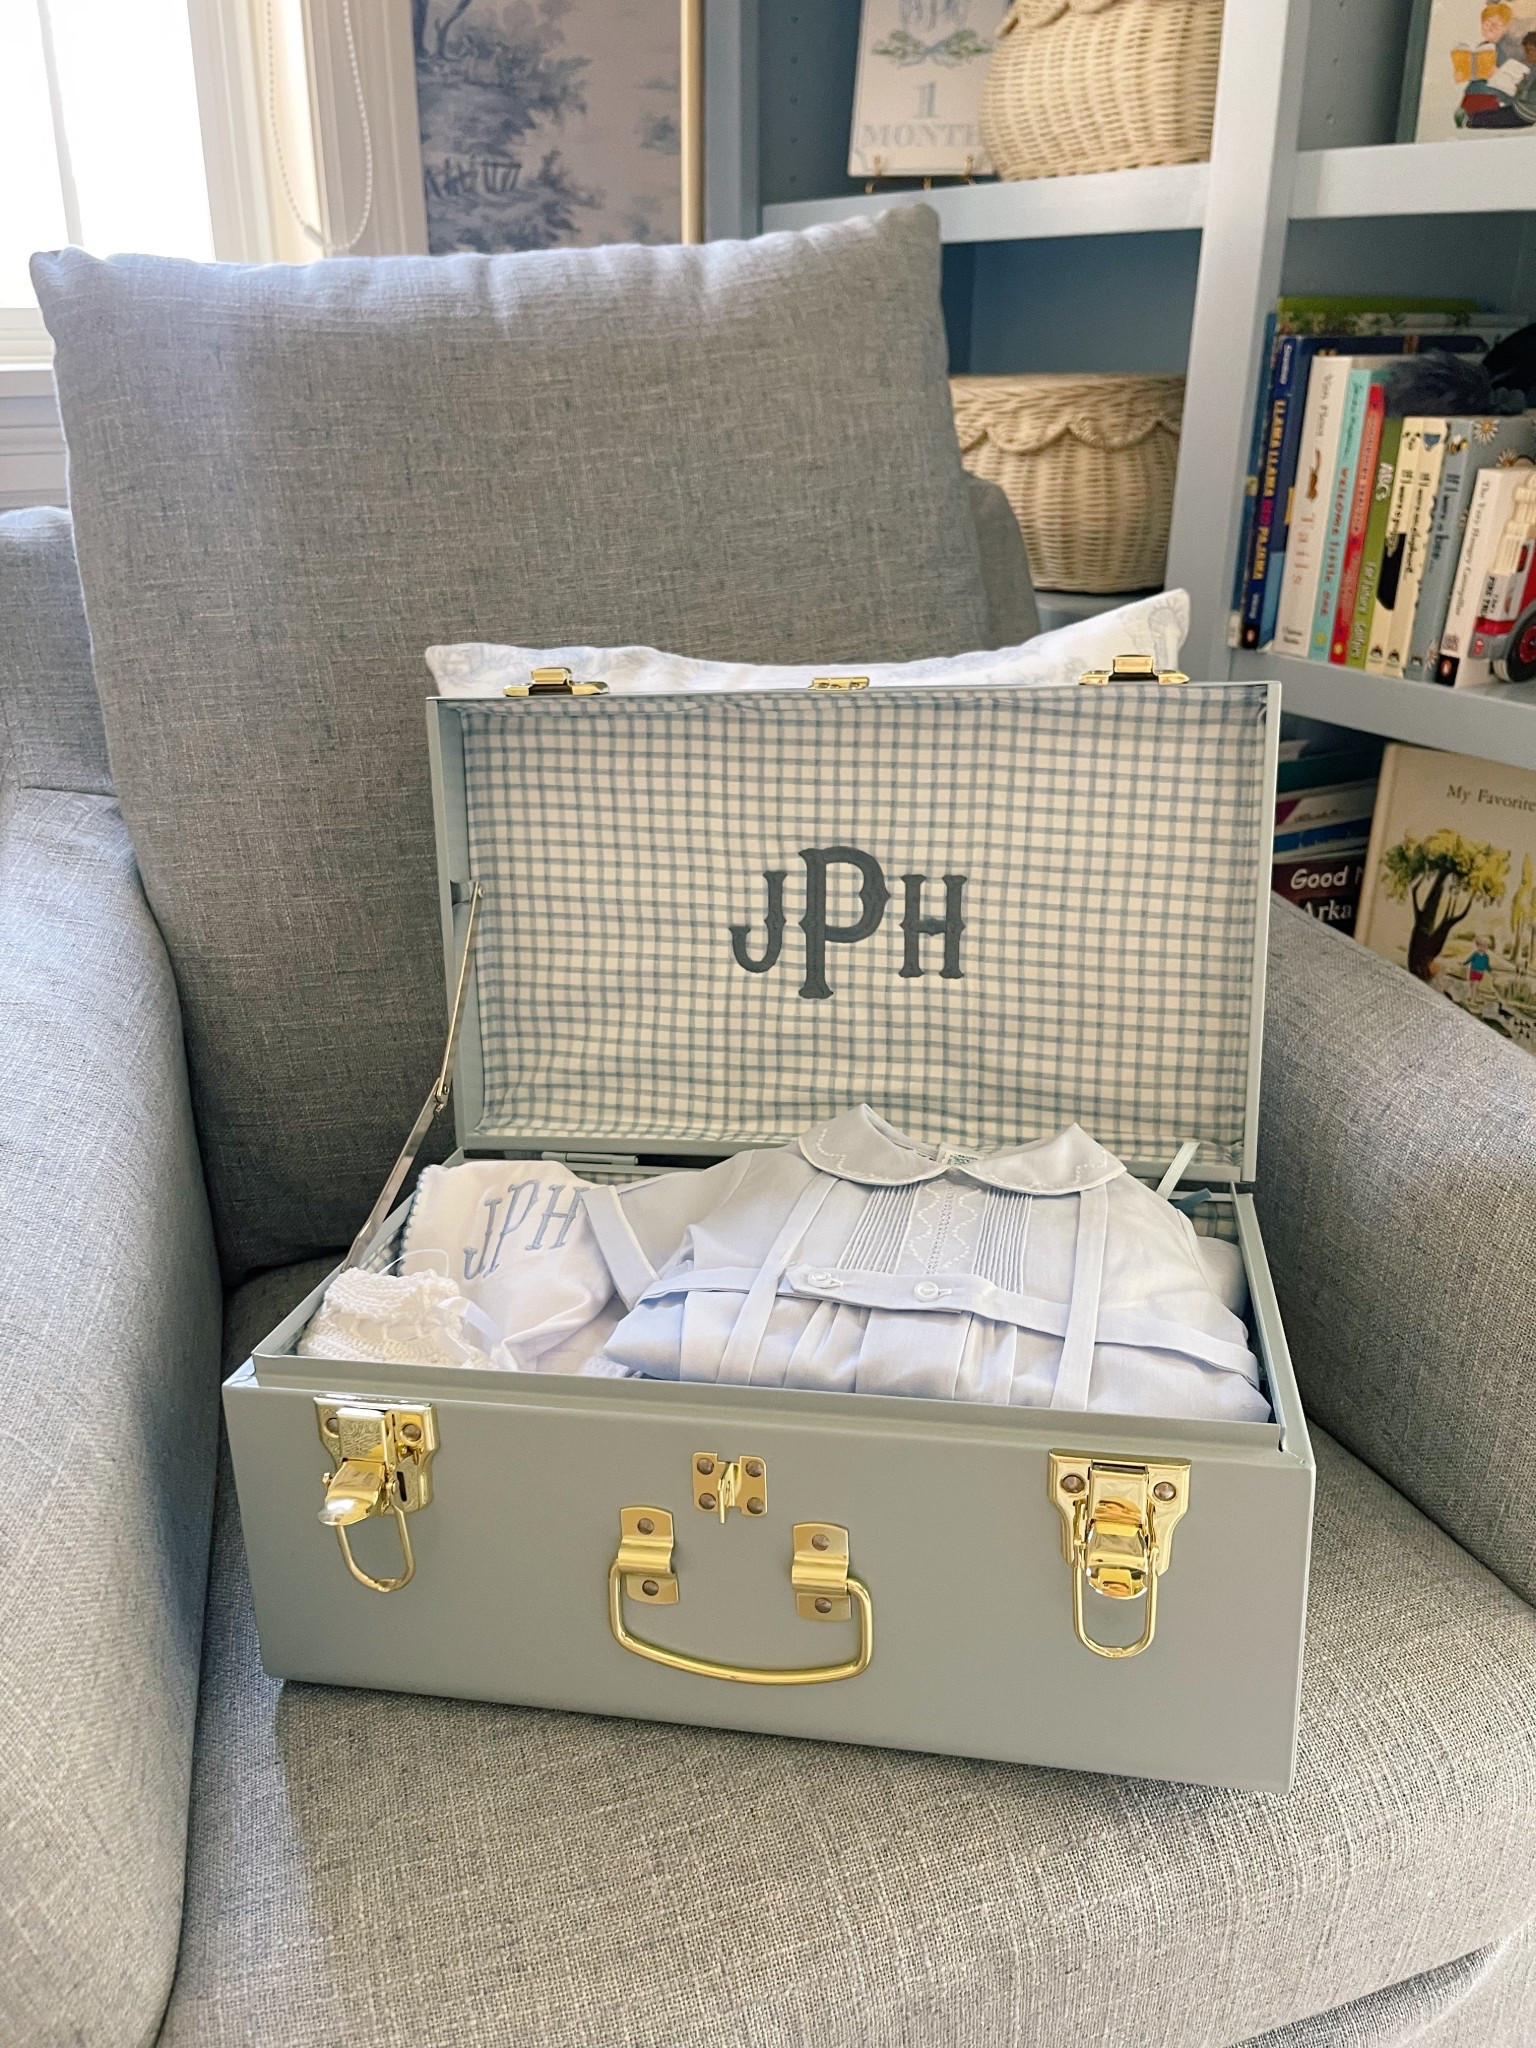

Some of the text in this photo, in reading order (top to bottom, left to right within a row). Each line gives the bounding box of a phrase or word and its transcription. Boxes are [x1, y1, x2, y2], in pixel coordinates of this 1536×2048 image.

[913, 81, 940, 119] 1
[1268, 399, 1287, 449] LLAMA
[1263, 450, 1281, 497] LLAMA
[1479, 481, 1491, 499] The
[1331, 467, 1350, 536] welcome
[1472, 502, 1486, 525] Very
[1252, 526, 1270, 580] PAJAMA
[1291, 512, 1317, 586] Tails
[1463, 528, 1480, 564] Hungry
[1446, 784, 1536, 812] My Favorite
[1290, 865, 1348, 890] Good
[729, 846, 967, 999] JPH
[463, 1180, 590, 1280] JPH
